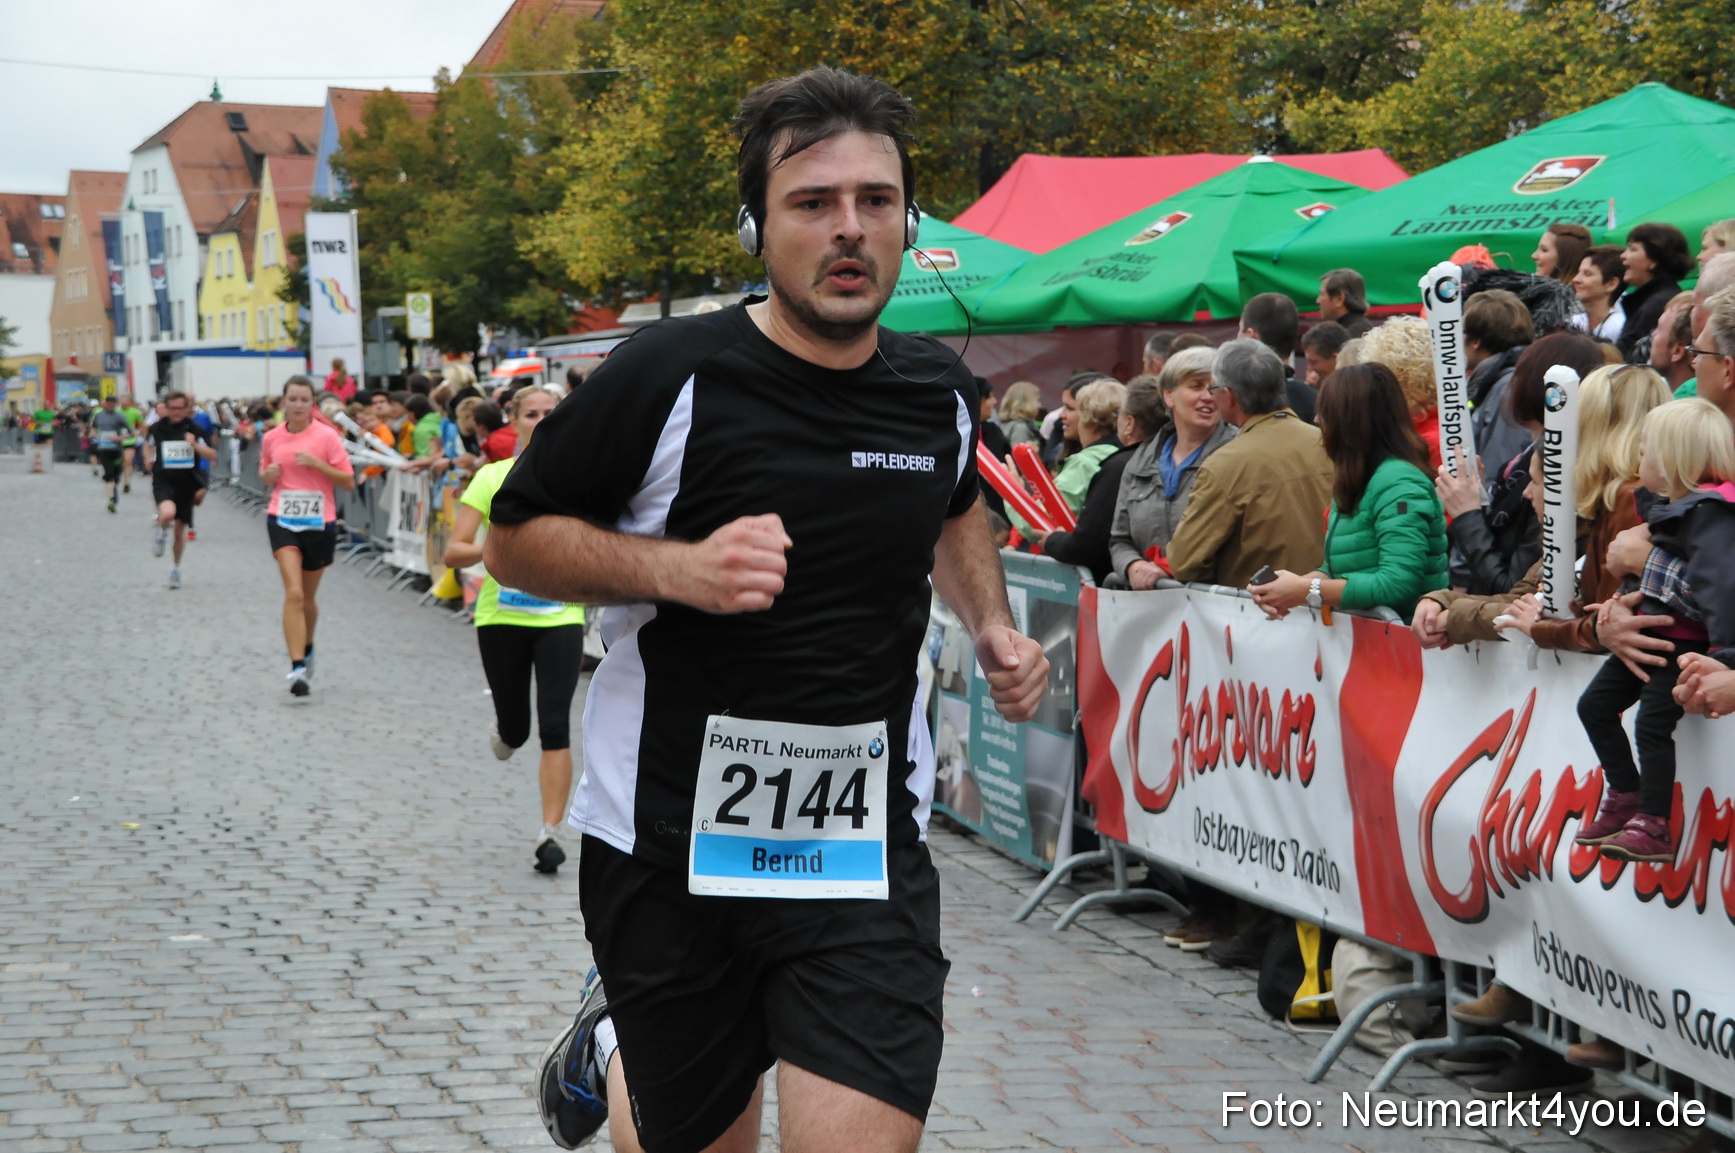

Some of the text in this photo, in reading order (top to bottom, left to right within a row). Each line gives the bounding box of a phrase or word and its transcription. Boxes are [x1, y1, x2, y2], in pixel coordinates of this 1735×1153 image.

[1440, 198, 1606, 216] Neumarkter
[867, 452, 935, 472] PFLEIDERER
[1544, 428, 1562, 494] BMW
[284, 500, 319, 515] 2574
[1127, 620, 1322, 814] Charivari
[709, 733, 862, 760] PARTL Neumarkt
[715, 763, 869, 830] 2144
[752, 847, 823, 873] Bernd
[1194, 806, 1340, 892] Ostbayerns Radio
[1533, 919, 1666, 1029] Ostbayerns
